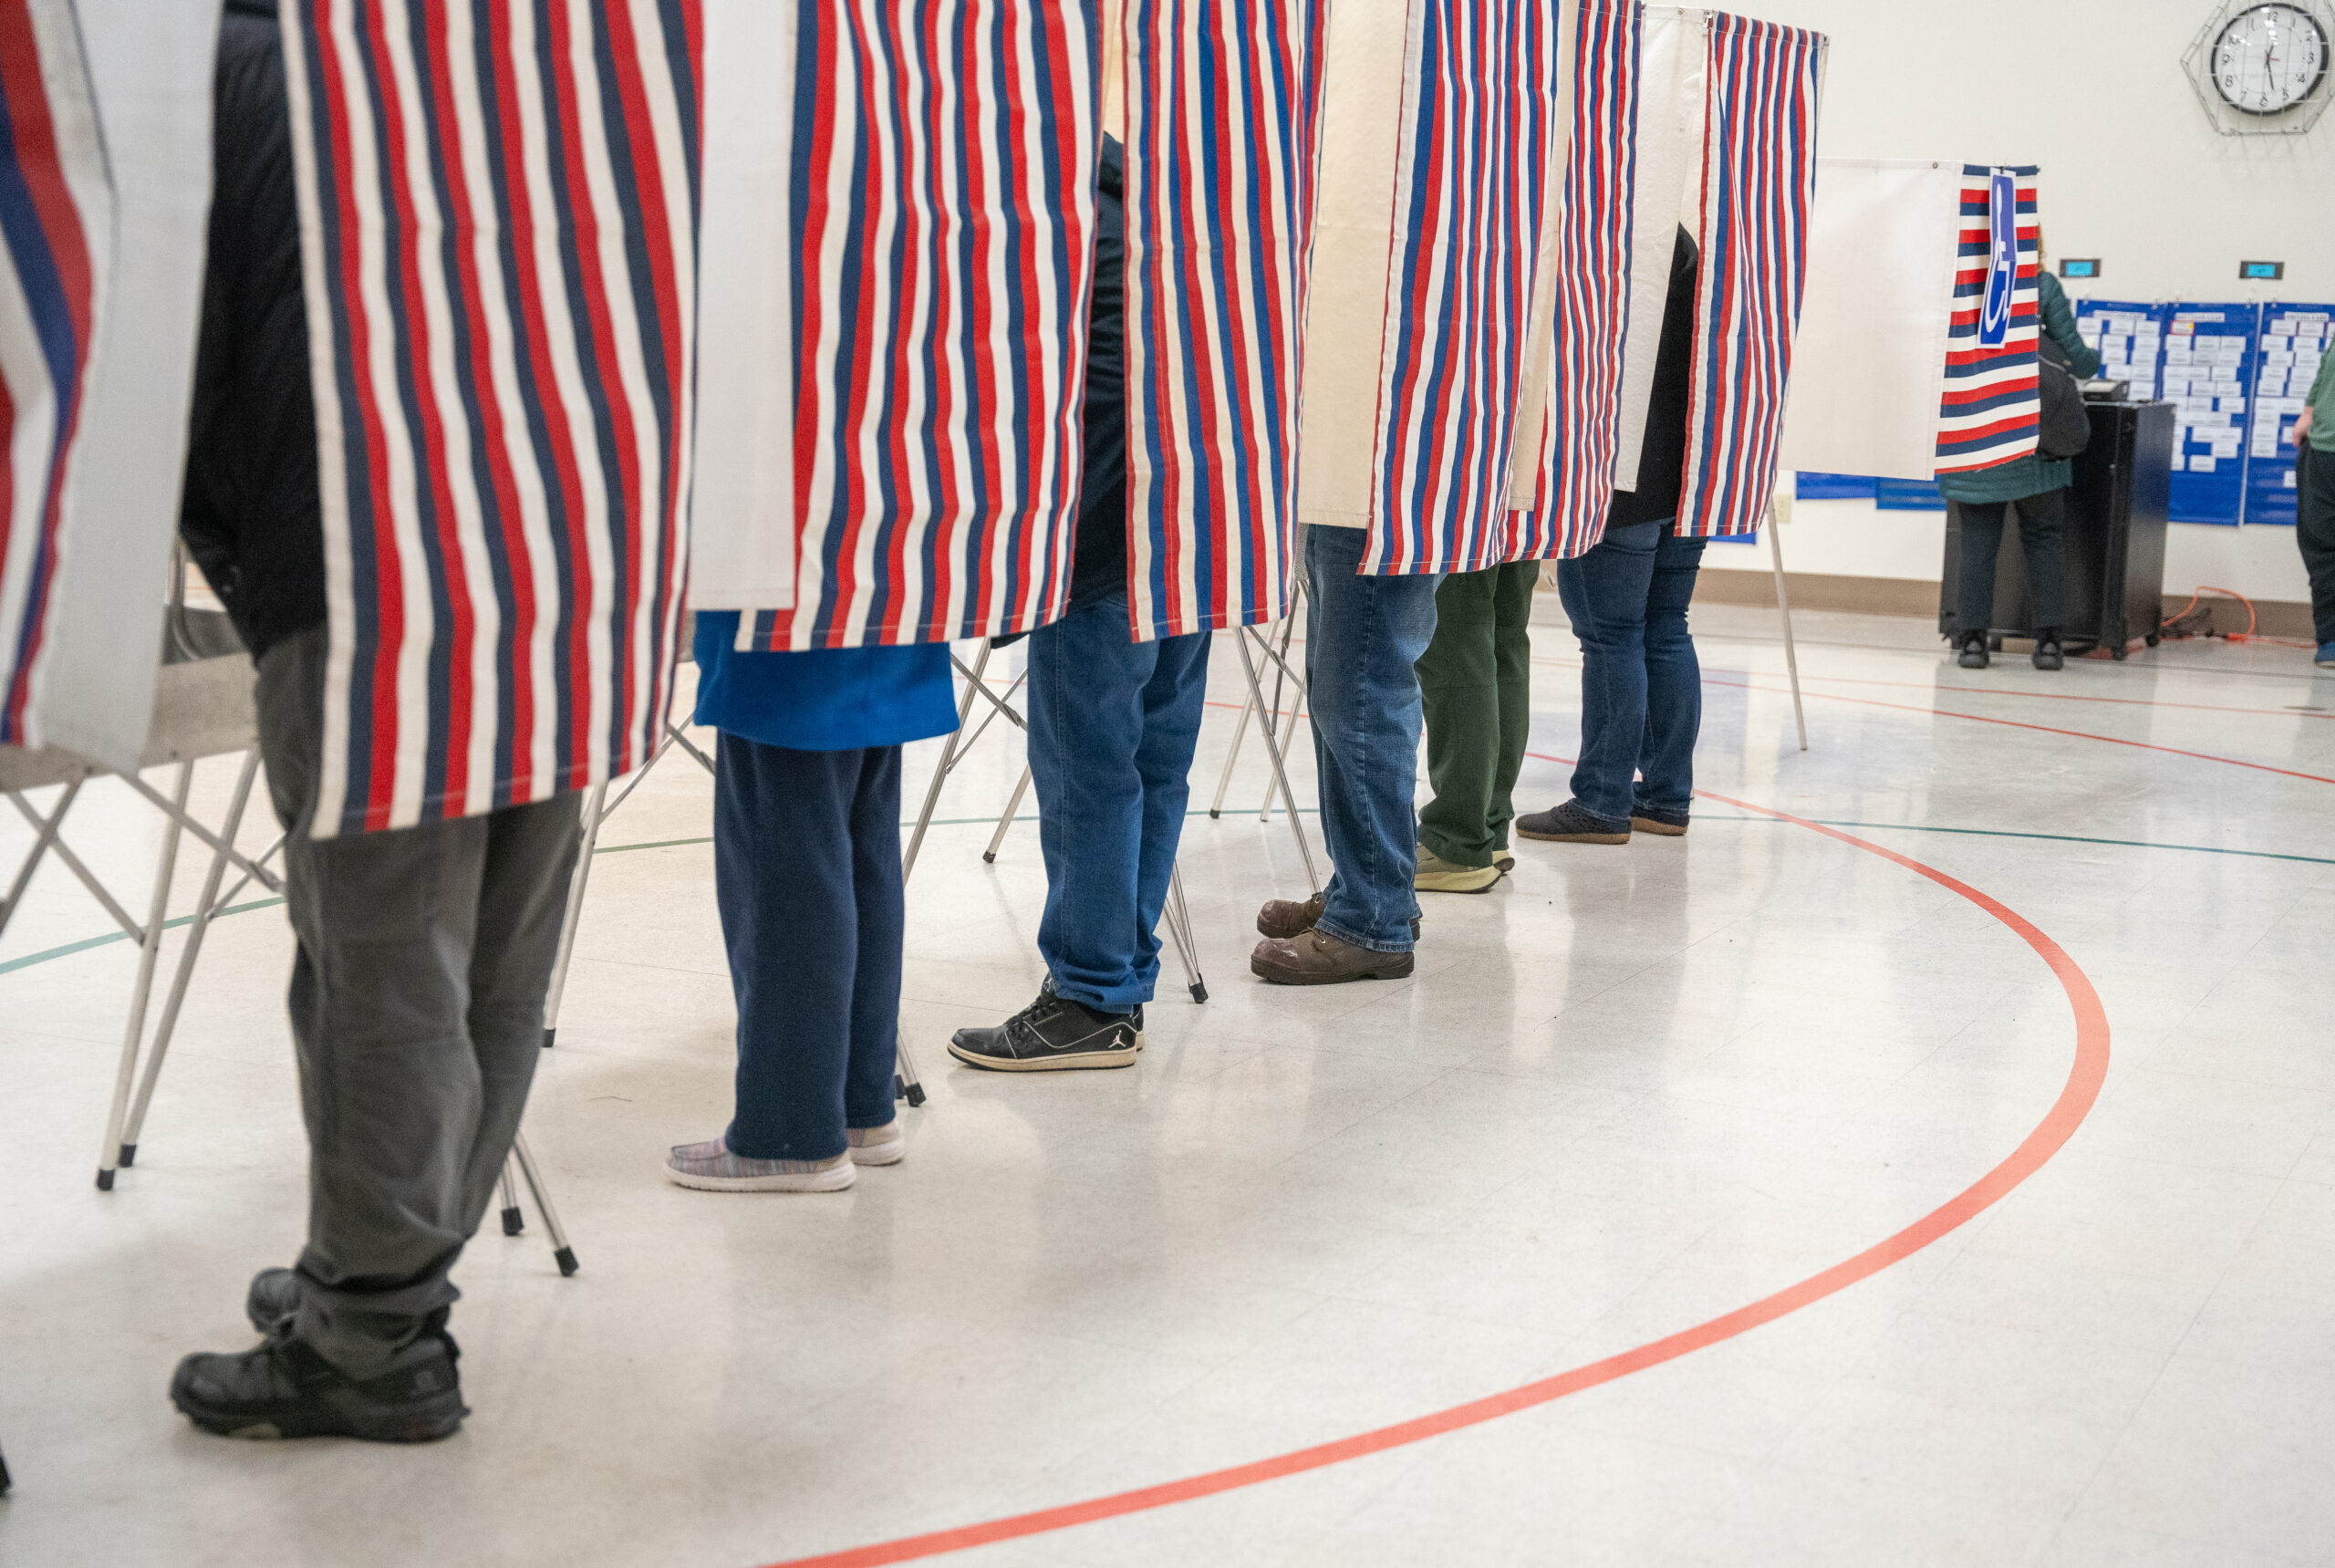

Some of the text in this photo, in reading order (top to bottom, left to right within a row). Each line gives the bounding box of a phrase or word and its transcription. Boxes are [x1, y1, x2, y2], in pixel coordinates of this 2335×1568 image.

[2268, 11, 2278, 22] 12
[2222, 54, 2230, 65] 9
[2307, 52, 2315, 65] 3
[2225, 75, 2233, 88] 8
[2282, 86, 2288, 100] 5
[2259, 93, 2268, 107] 6
